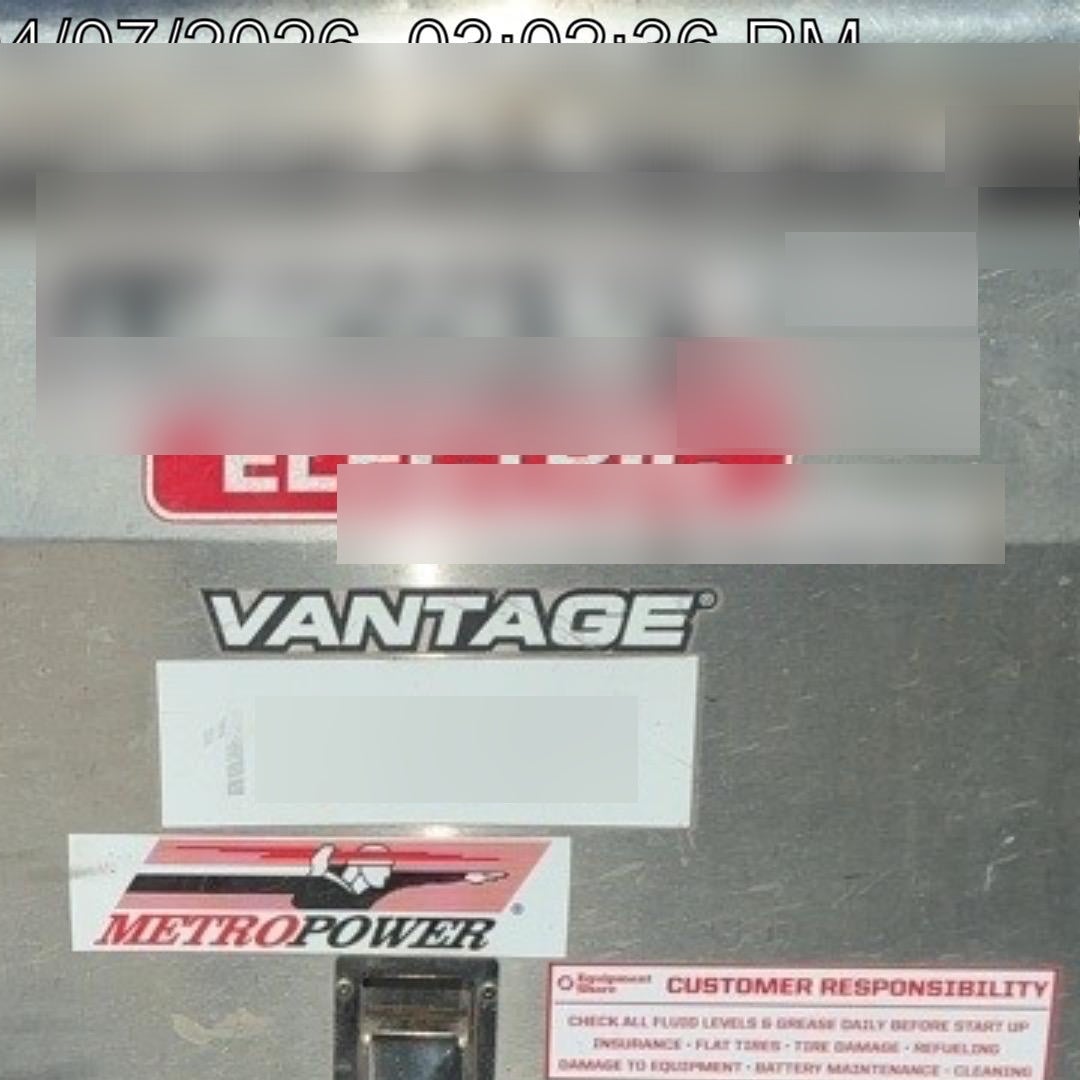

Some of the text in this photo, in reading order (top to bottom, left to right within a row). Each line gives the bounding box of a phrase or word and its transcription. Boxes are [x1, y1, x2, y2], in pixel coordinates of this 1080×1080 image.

[203, 589, 702, 652] VANTAGE
[93, 912, 498, 950] METROPOWER
[666, 976, 1049, 998] CUSTOMER RESPONSIBILITY
[568, 1015, 618, 1027] CHECK
[621, 1016, 649, 1028] ALL
[703, 1017, 757, 1030] LEVELS
[777, 1018, 835, 1031] GREASE
[841, 1019, 886, 1032] DAILY
[891, 1020, 949, 1033] BEFORE
[954, 1021, 1003, 1034] START
[1008, 1021, 1030, 1034] UP
[594, 1038, 1001, 1055] INSURANCE FLAT TIRES TIRE DAMAGE REFUELING
[558, 1059, 1033, 1078] DAMAGE TO EQUIPMENT BATTERY MAINTENANCE CLEANING
